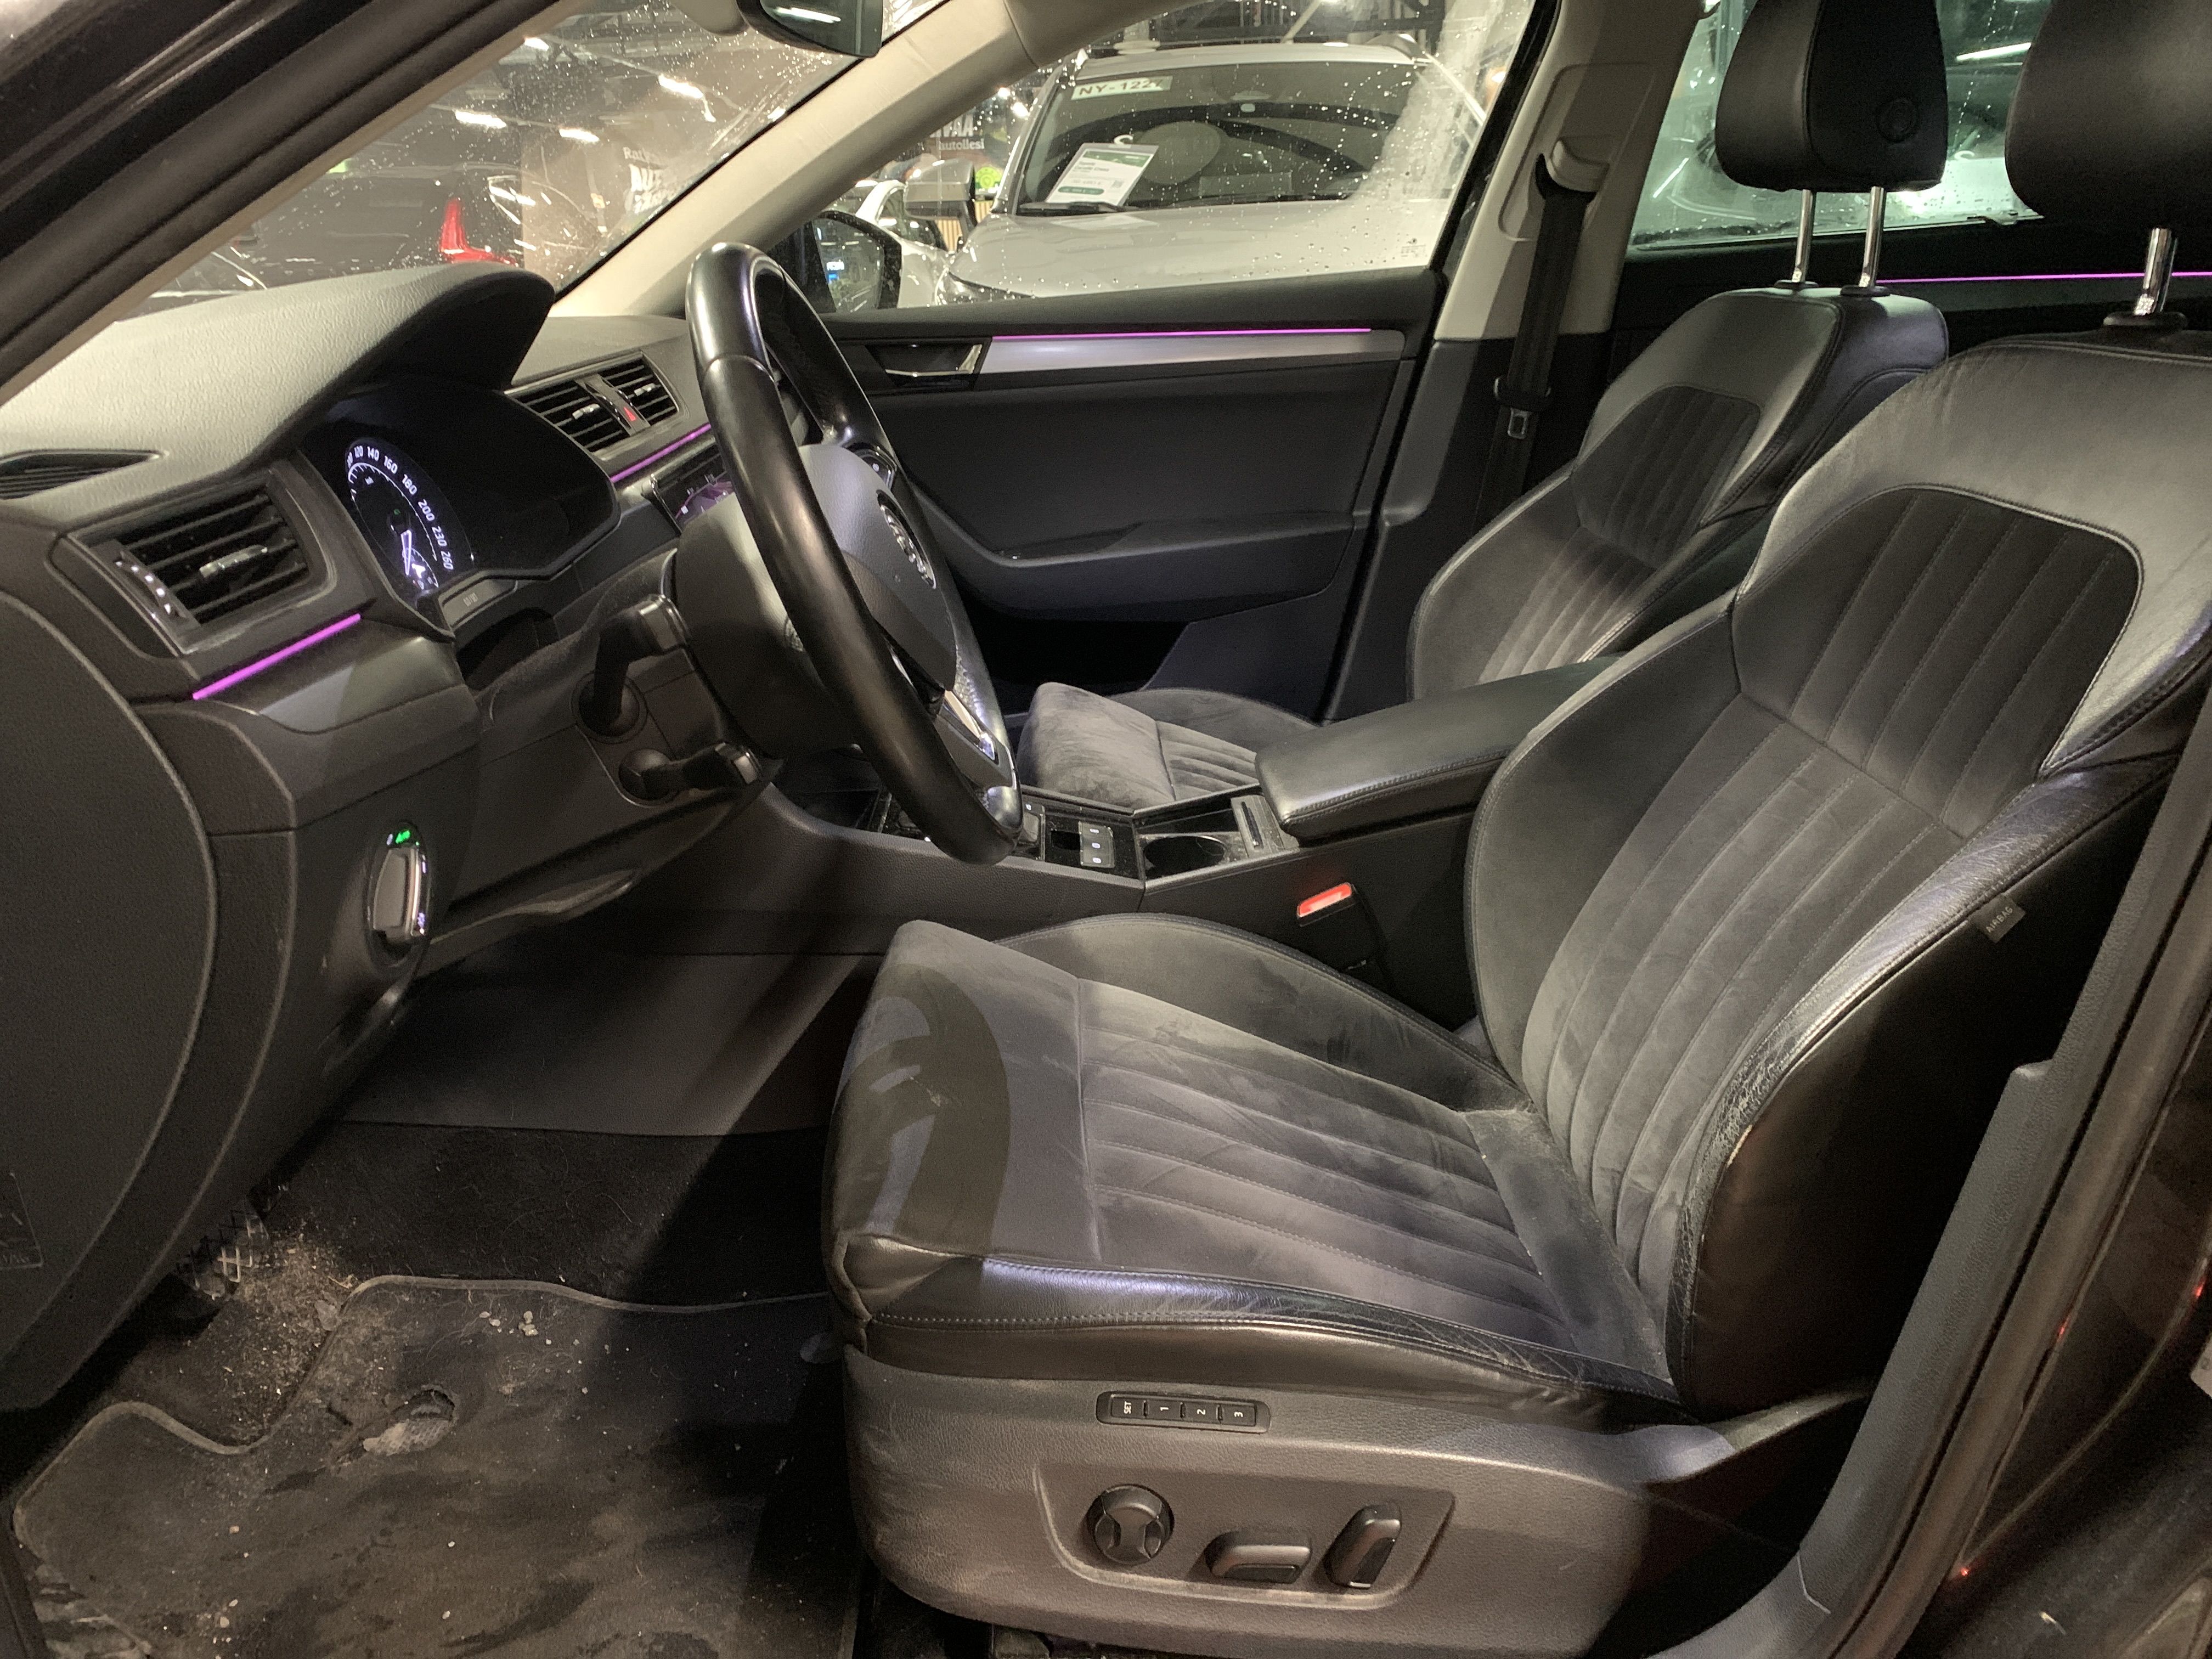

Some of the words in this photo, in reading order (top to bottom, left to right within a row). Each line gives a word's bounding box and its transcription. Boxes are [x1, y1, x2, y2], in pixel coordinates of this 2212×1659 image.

[354, 445, 364, 458] 120
[367, 446, 380, 461] 140
[384, 455, 398, 474] 160
[402, 474, 417, 495] 180
[417, 499, 435, 521] 200
[432, 526, 447, 546] 230
[441, 550, 454, 570] 260
[1985, 906, 2013, 933] AIRBAG
[1124, 1401, 1132, 1414] SET
